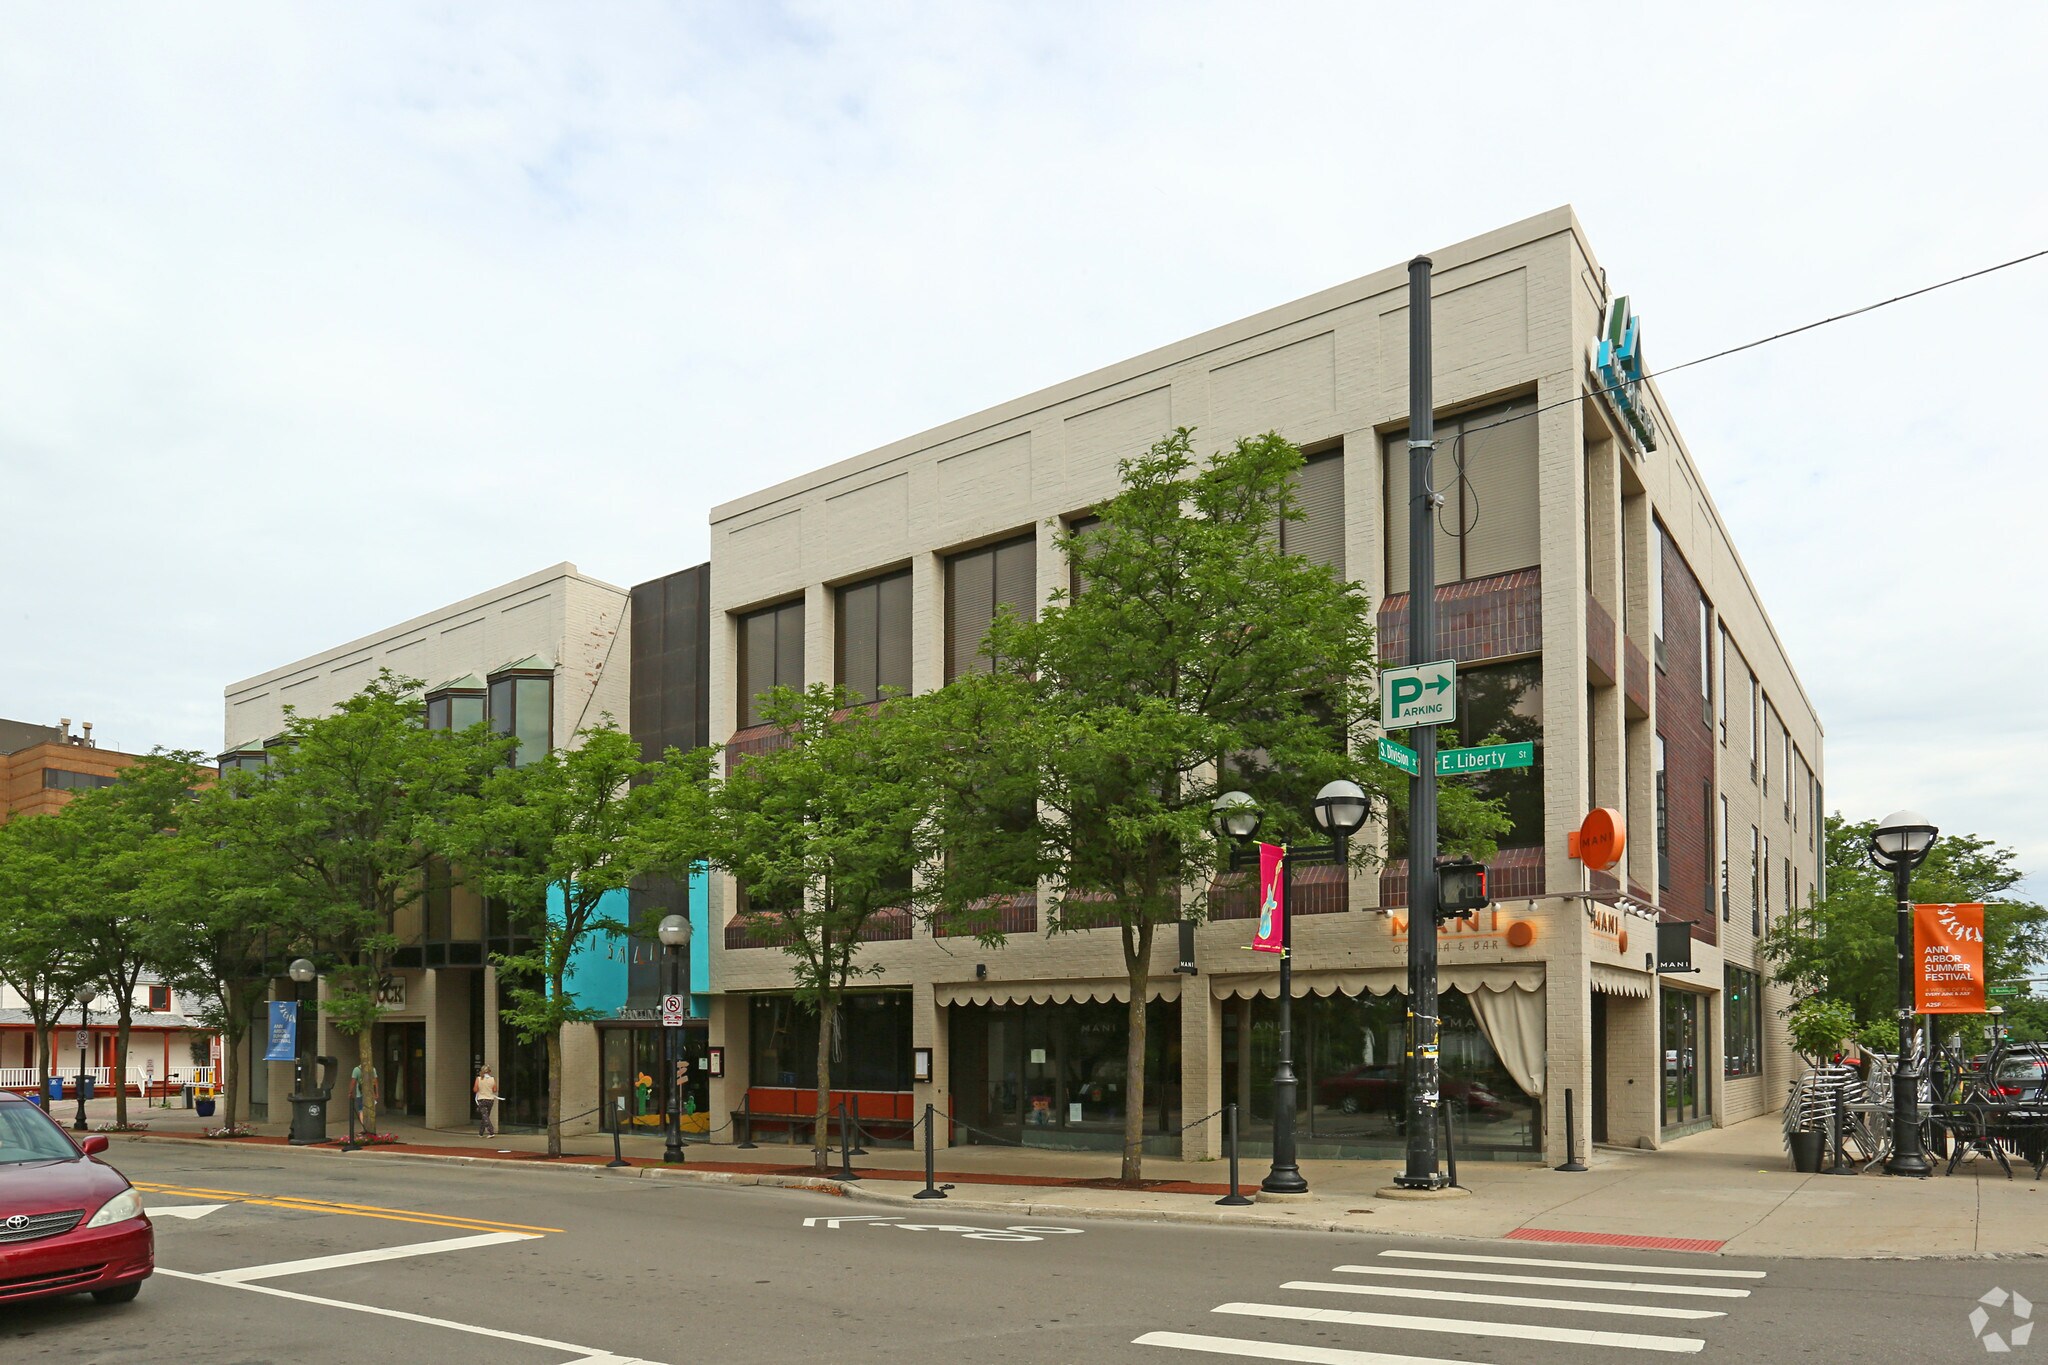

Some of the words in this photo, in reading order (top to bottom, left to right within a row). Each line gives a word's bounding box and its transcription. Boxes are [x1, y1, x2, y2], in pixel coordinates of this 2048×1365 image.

[1380, 741, 1387, 758] S.
[1386, 744, 1409, 767] Division
[1442, 754, 1455, 770] E.
[1457, 751, 1506, 768] Liberty
[1518, 750, 1527, 759] St
[1582, 832, 1612, 847] MANI
[1392, 911, 1497, 937] MNI
[1473, 940, 1498, 950] BAR
[1924, 946, 1949, 954] ANN
[1924, 955, 1962, 963] ARBOR
[1660, 961, 1689, 969] MANI
[1924, 964, 1971, 972] SUMMER
[1925, 973, 1974, 981] FESTIVAL
